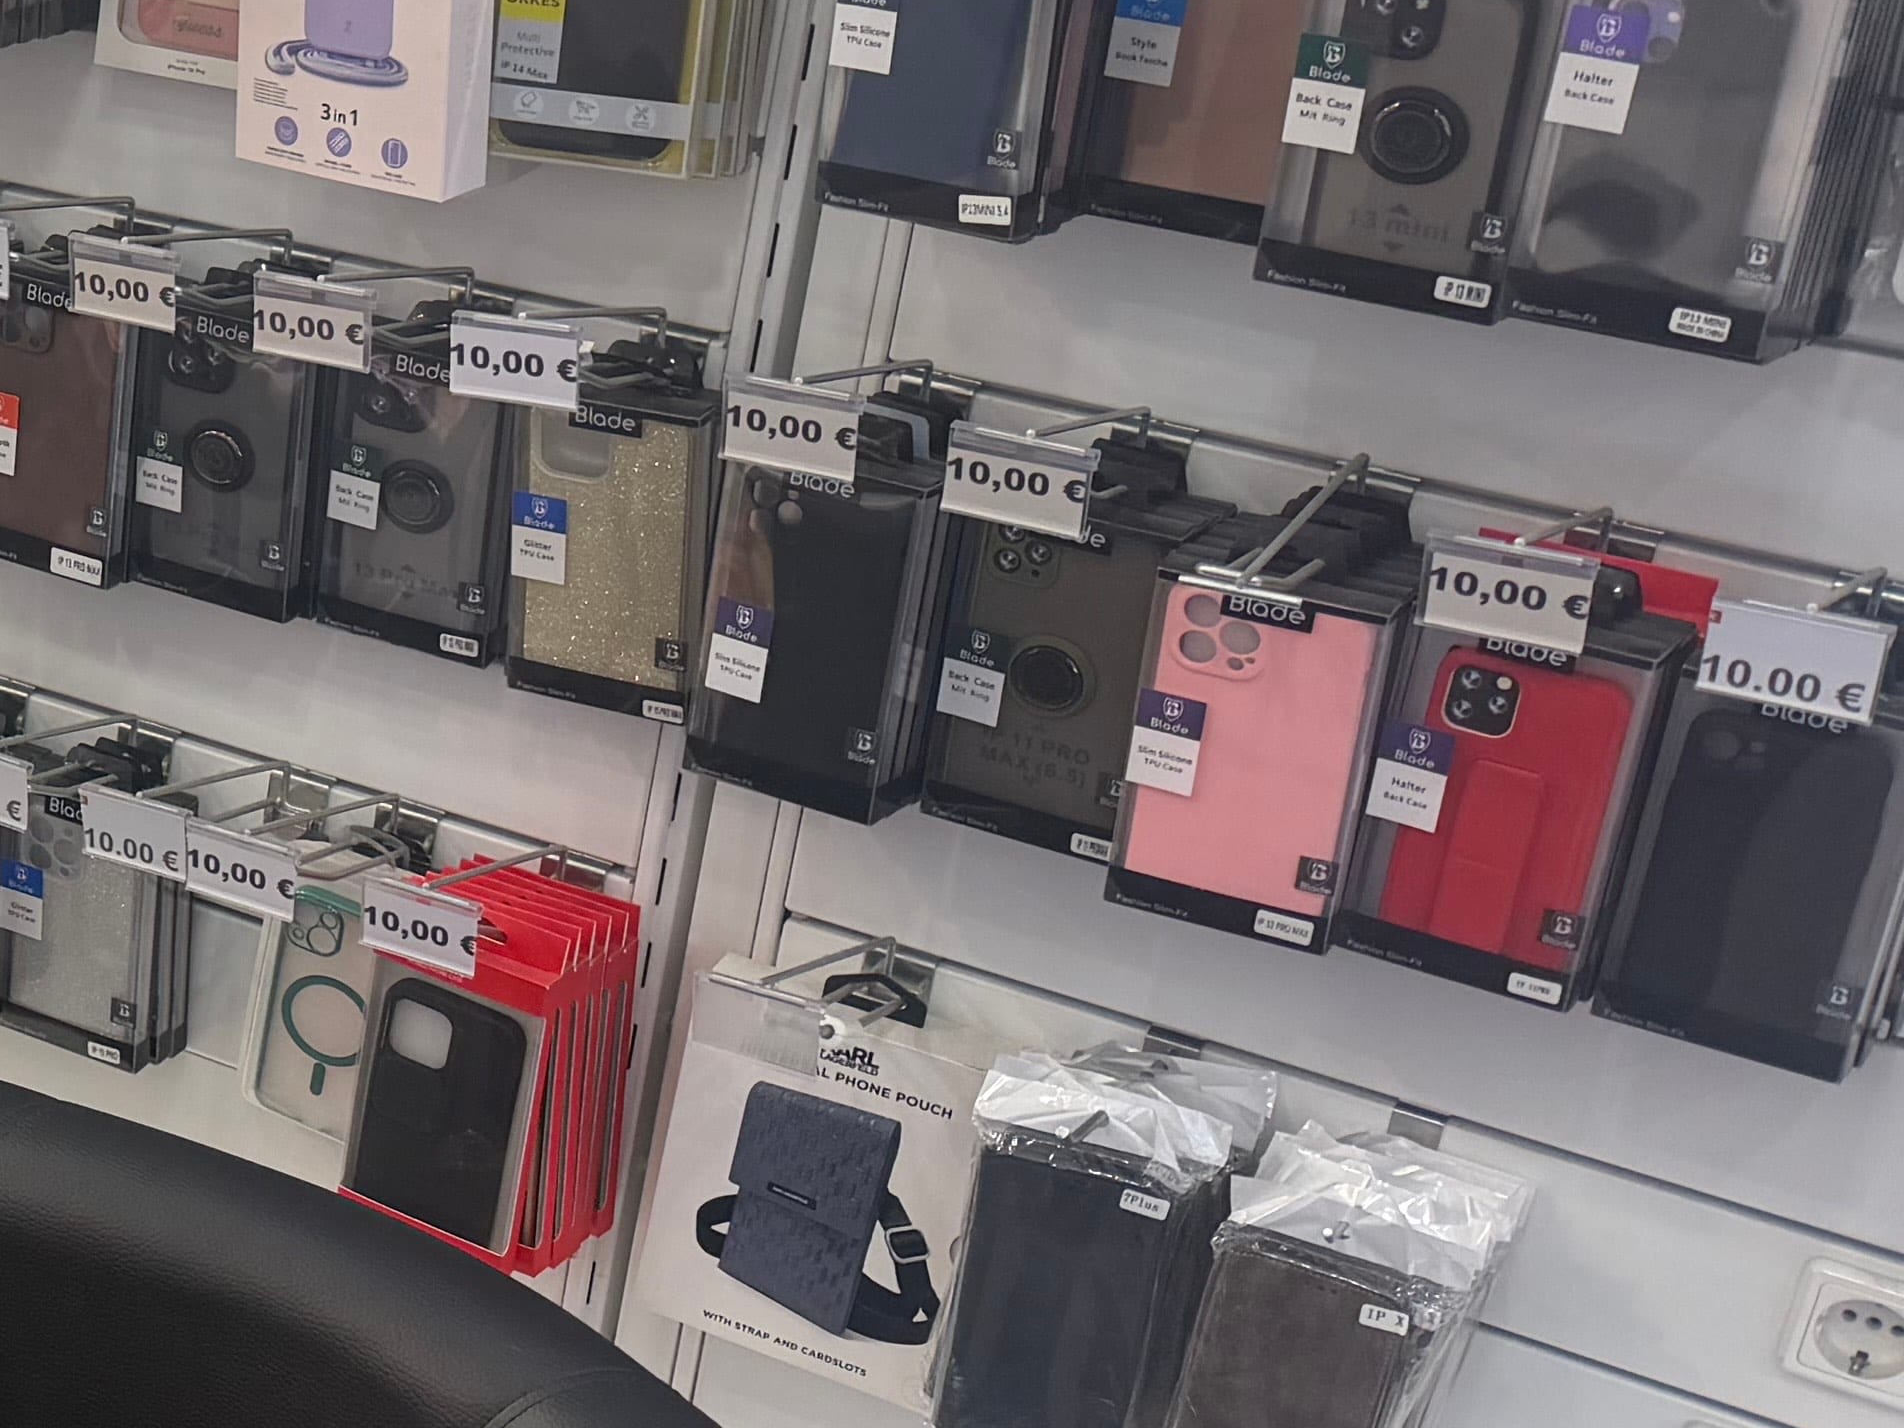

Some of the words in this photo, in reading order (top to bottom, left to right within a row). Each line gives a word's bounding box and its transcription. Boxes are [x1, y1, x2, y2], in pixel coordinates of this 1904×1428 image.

[1573, 71, 1613, 87] Halter
[254, 310, 335, 342] 10,00
[345, 324, 365, 345] €
[451, 343, 545, 377] 10,00
[557, 358, 577, 382] €
[576, 405, 635, 432] Blade
[727, 405, 822, 443] 10,00
[836, 427, 857, 451] €
[948, 456, 1051, 496] 10,00
[1064, 479, 1086, 504] €
[1430, 567, 1548, 612] 10,00
[1563, 592, 1589, 620] €
[1701, 654, 1822, 703] 10.00
[1836, 681, 1865, 712] €
[7, 799, 22, 821] €
[85, 826, 154, 864] 10.00
[162, 849, 178, 872] €
[188, 847, 266, 889] 10,00
[278, 878, 294, 899] €
[364, 906, 449, 948] 10,00
[460, 934, 477, 956] €
[835, 1072, 891, 1099] PHONE
[895, 1092, 953, 1119] POUCH
[1366, 1307, 1386, 1322] IP
[1394, 1313, 1405, 1327] X
[703, 1310, 731, 1326] WITH
[735, 1321, 770, 1339] STRAP
[774, 1336, 798, 1351] AND
[801, 1346, 866, 1377] CARDSLOTS
